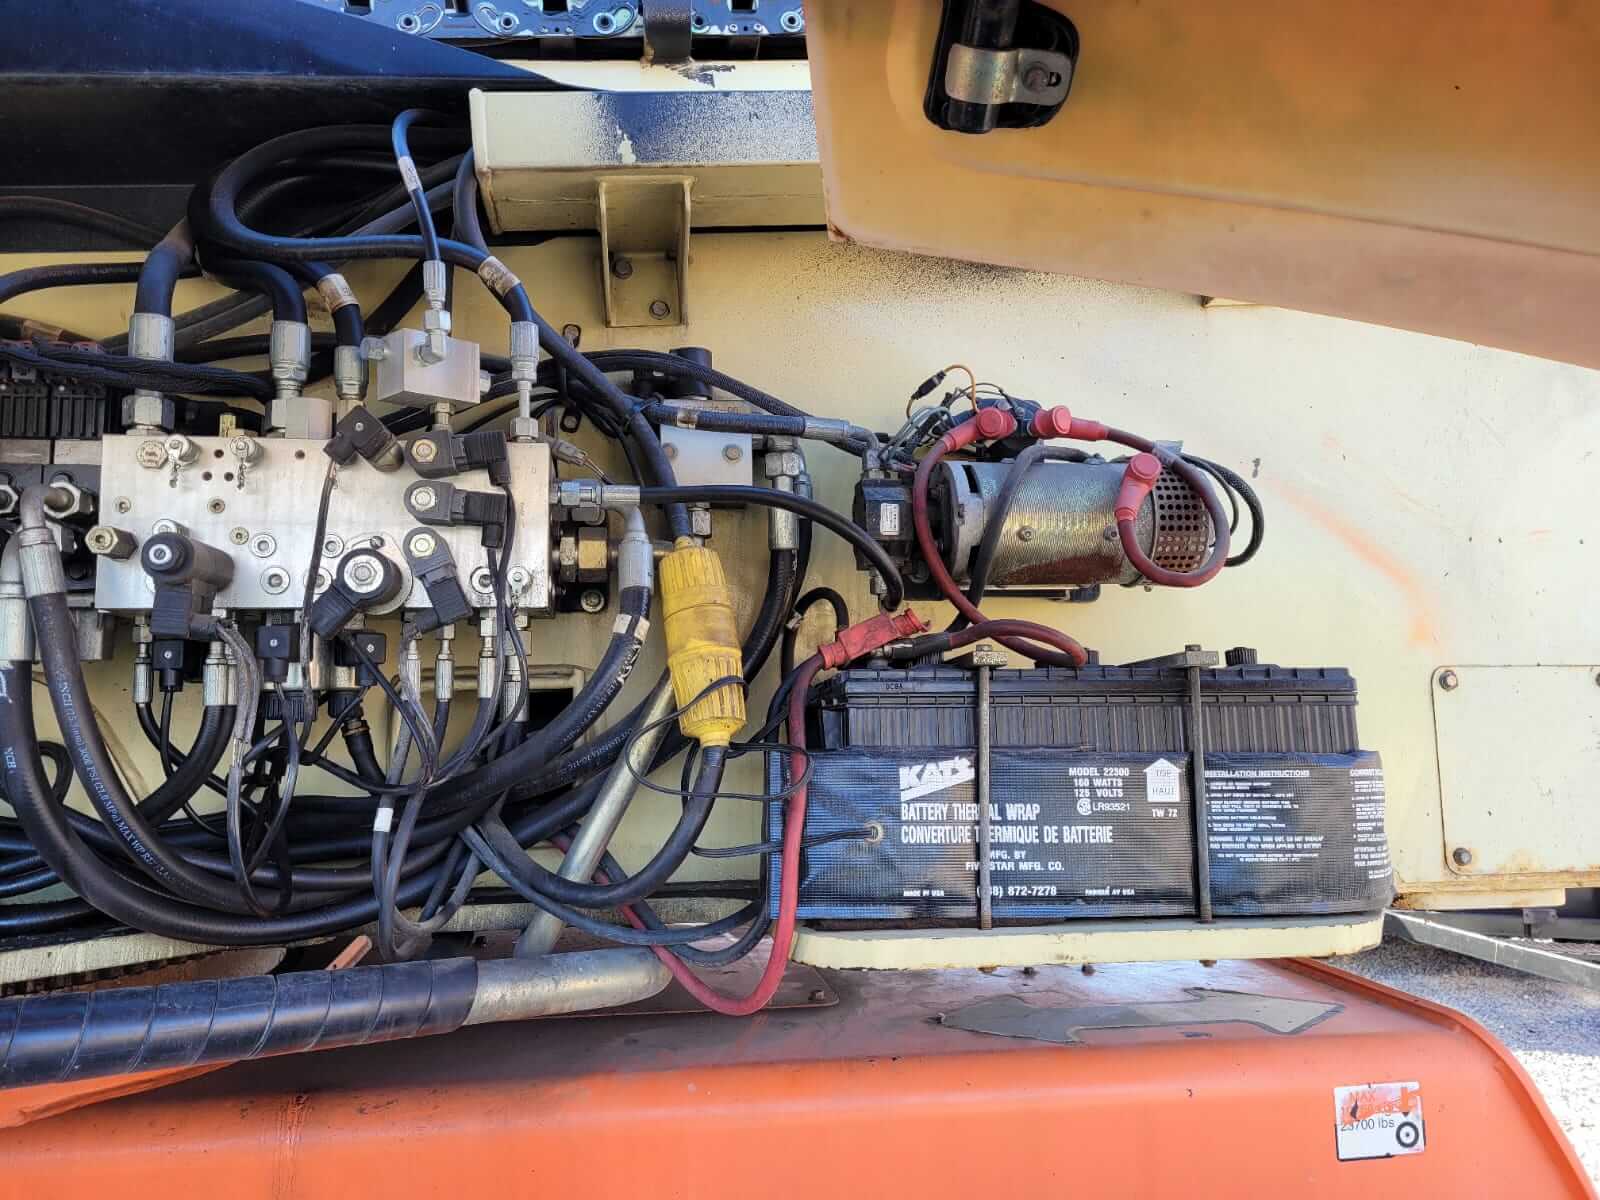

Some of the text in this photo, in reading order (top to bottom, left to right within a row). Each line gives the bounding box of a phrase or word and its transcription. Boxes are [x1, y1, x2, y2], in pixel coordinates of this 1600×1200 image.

[1069, 767, 1130, 776] MODEL 22300
[1093, 778, 1123, 787] WATTS
[1074, 788, 1124, 797] 125 VOLTS
[901, 803, 1041, 820] BATTERY THERAL WRAP
[1152, 808, 1164, 817] TW
[901, 825, 1113, 843] CONVERTURE TERMIQUE DE BATTERIE
[1014, 851, 1026, 859] BY
[1019, 862, 1044, 871] MFG.
[1048, 862, 1065, 871] CO.
[1008, 886, 1057, 896] 872-7278
[1378, 1119, 1395, 1129] lbs
